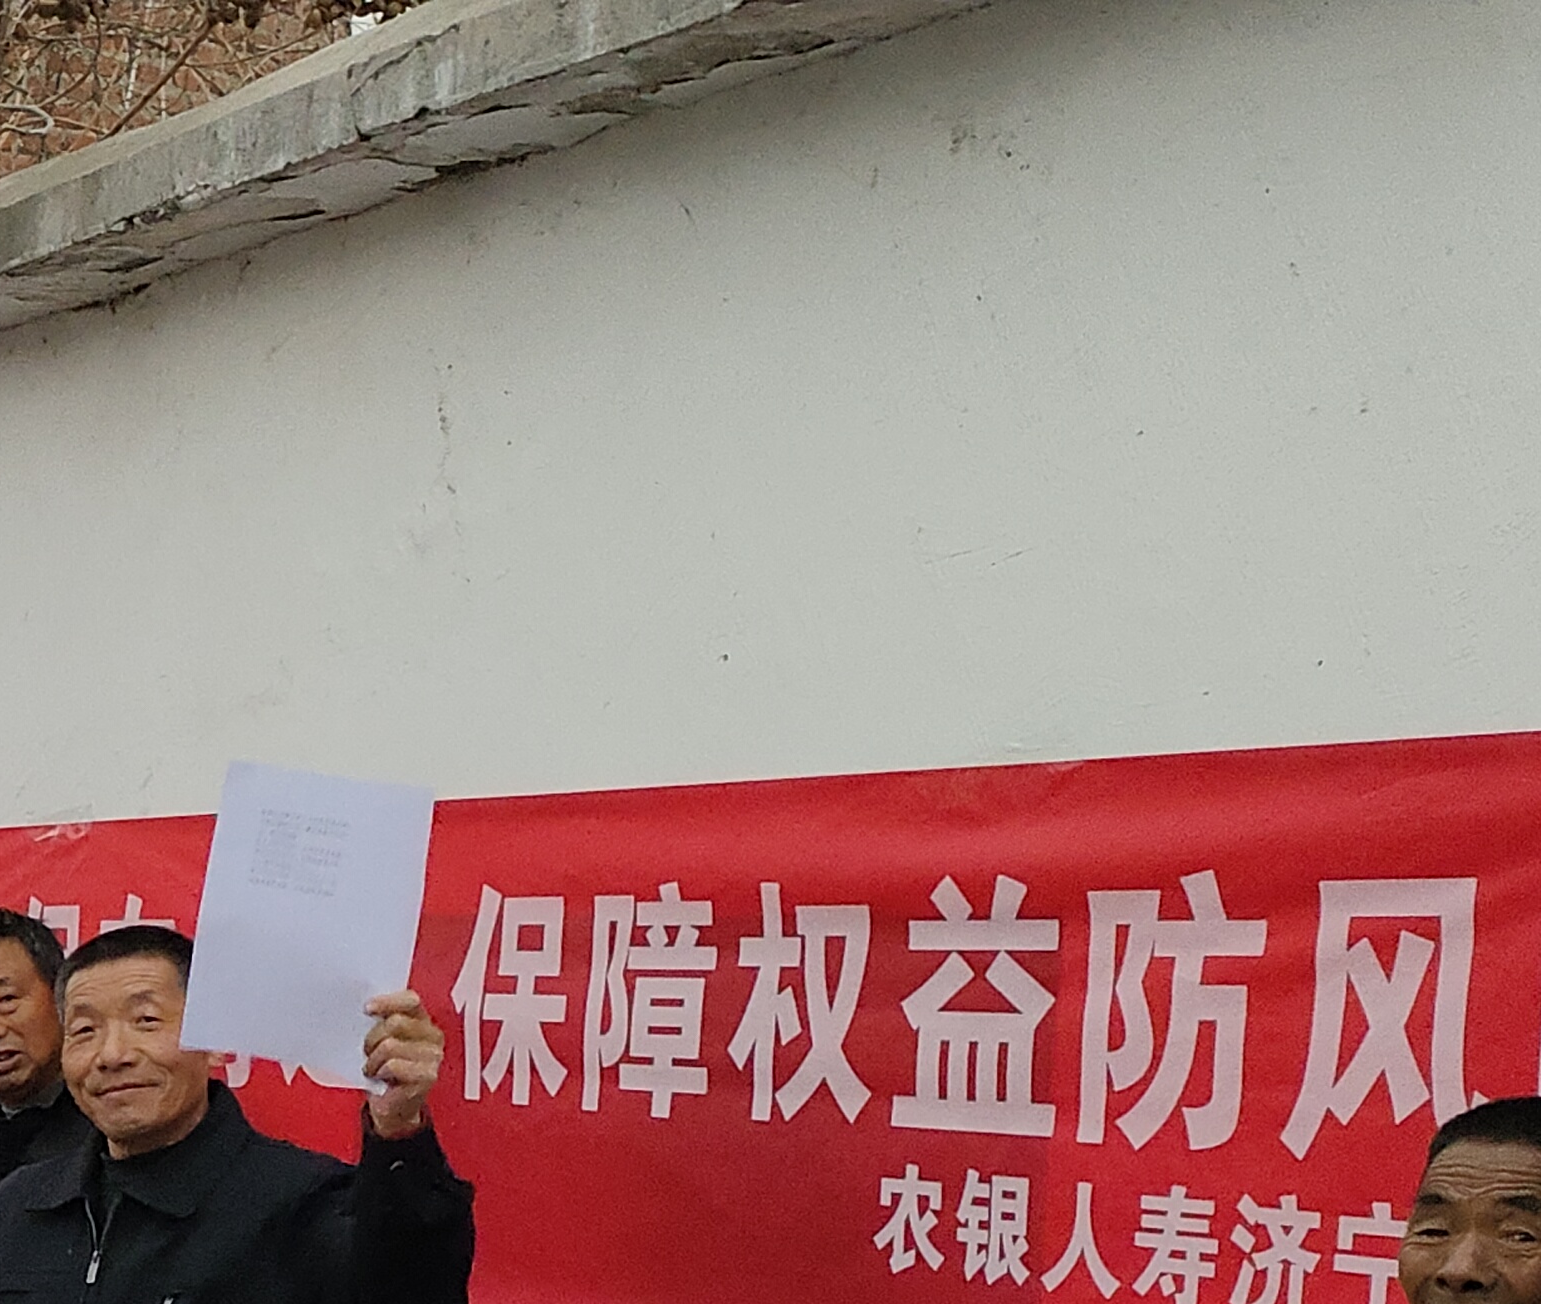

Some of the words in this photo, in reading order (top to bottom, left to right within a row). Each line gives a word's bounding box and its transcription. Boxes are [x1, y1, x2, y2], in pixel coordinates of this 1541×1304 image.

[450, 869, 1541, 1158] 保障权益防风
